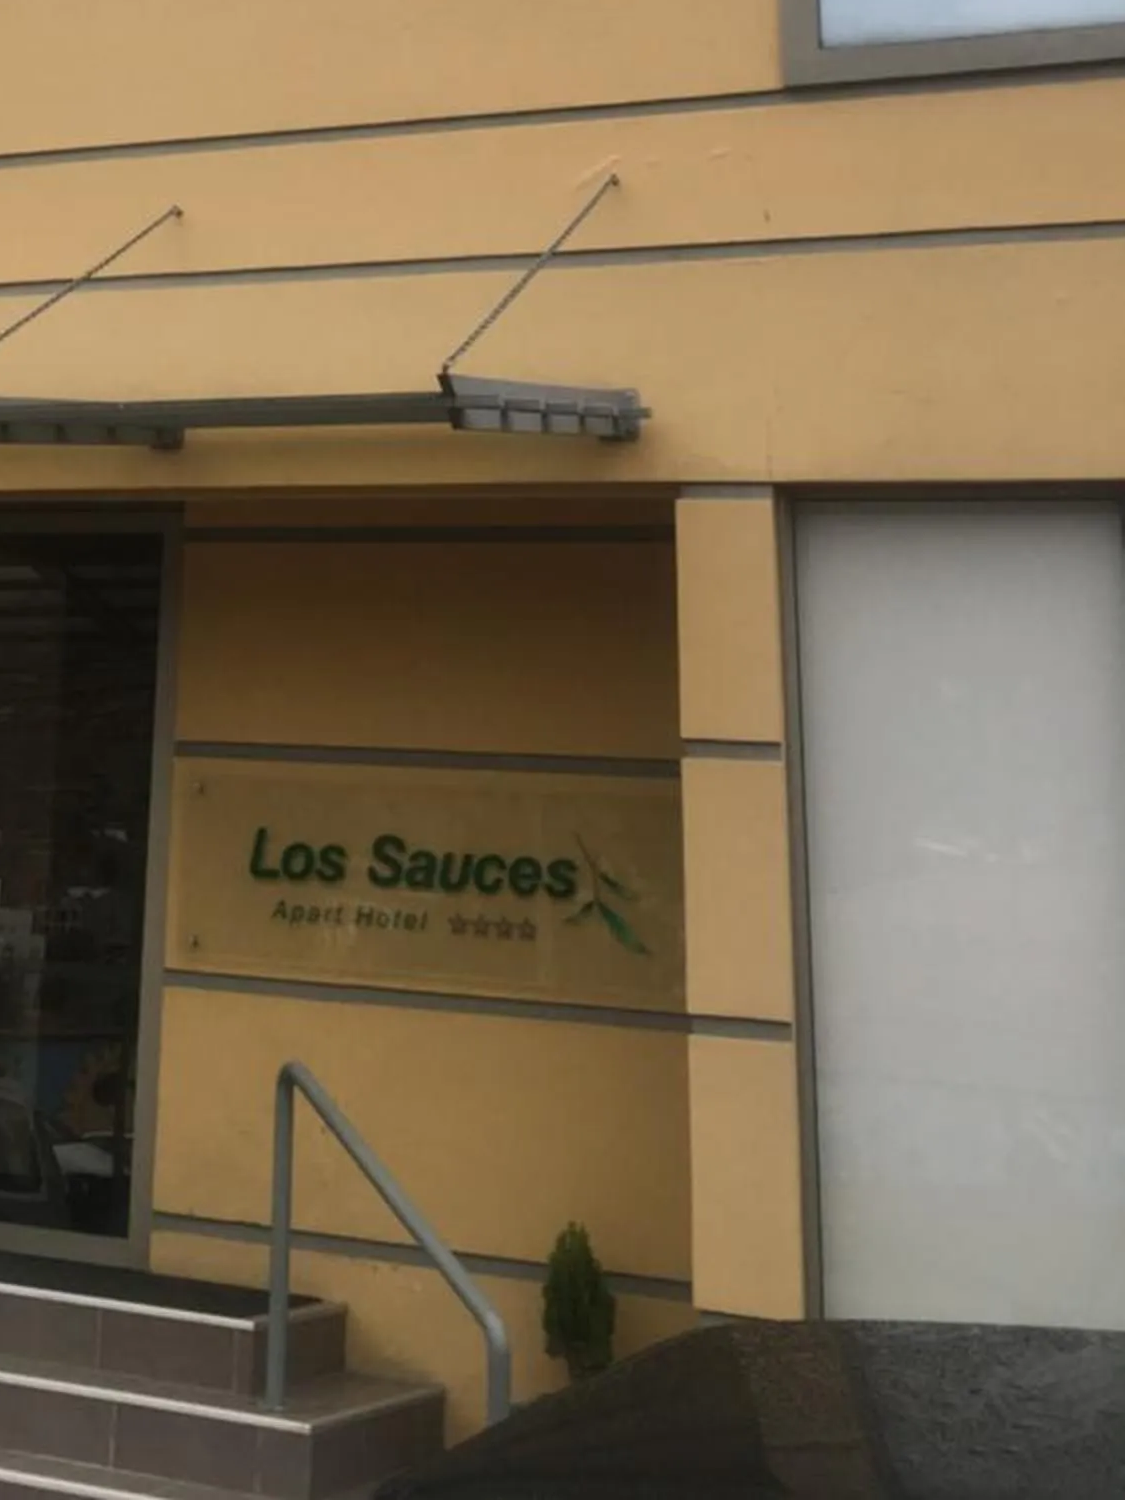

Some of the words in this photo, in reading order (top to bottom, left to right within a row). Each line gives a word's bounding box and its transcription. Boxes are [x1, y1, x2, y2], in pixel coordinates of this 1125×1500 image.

[248, 826, 348, 883] Los
[367, 834, 580, 901] Sauces
[270, 899, 343, 930] Apart
[354, 904, 429, 932] Hotel
